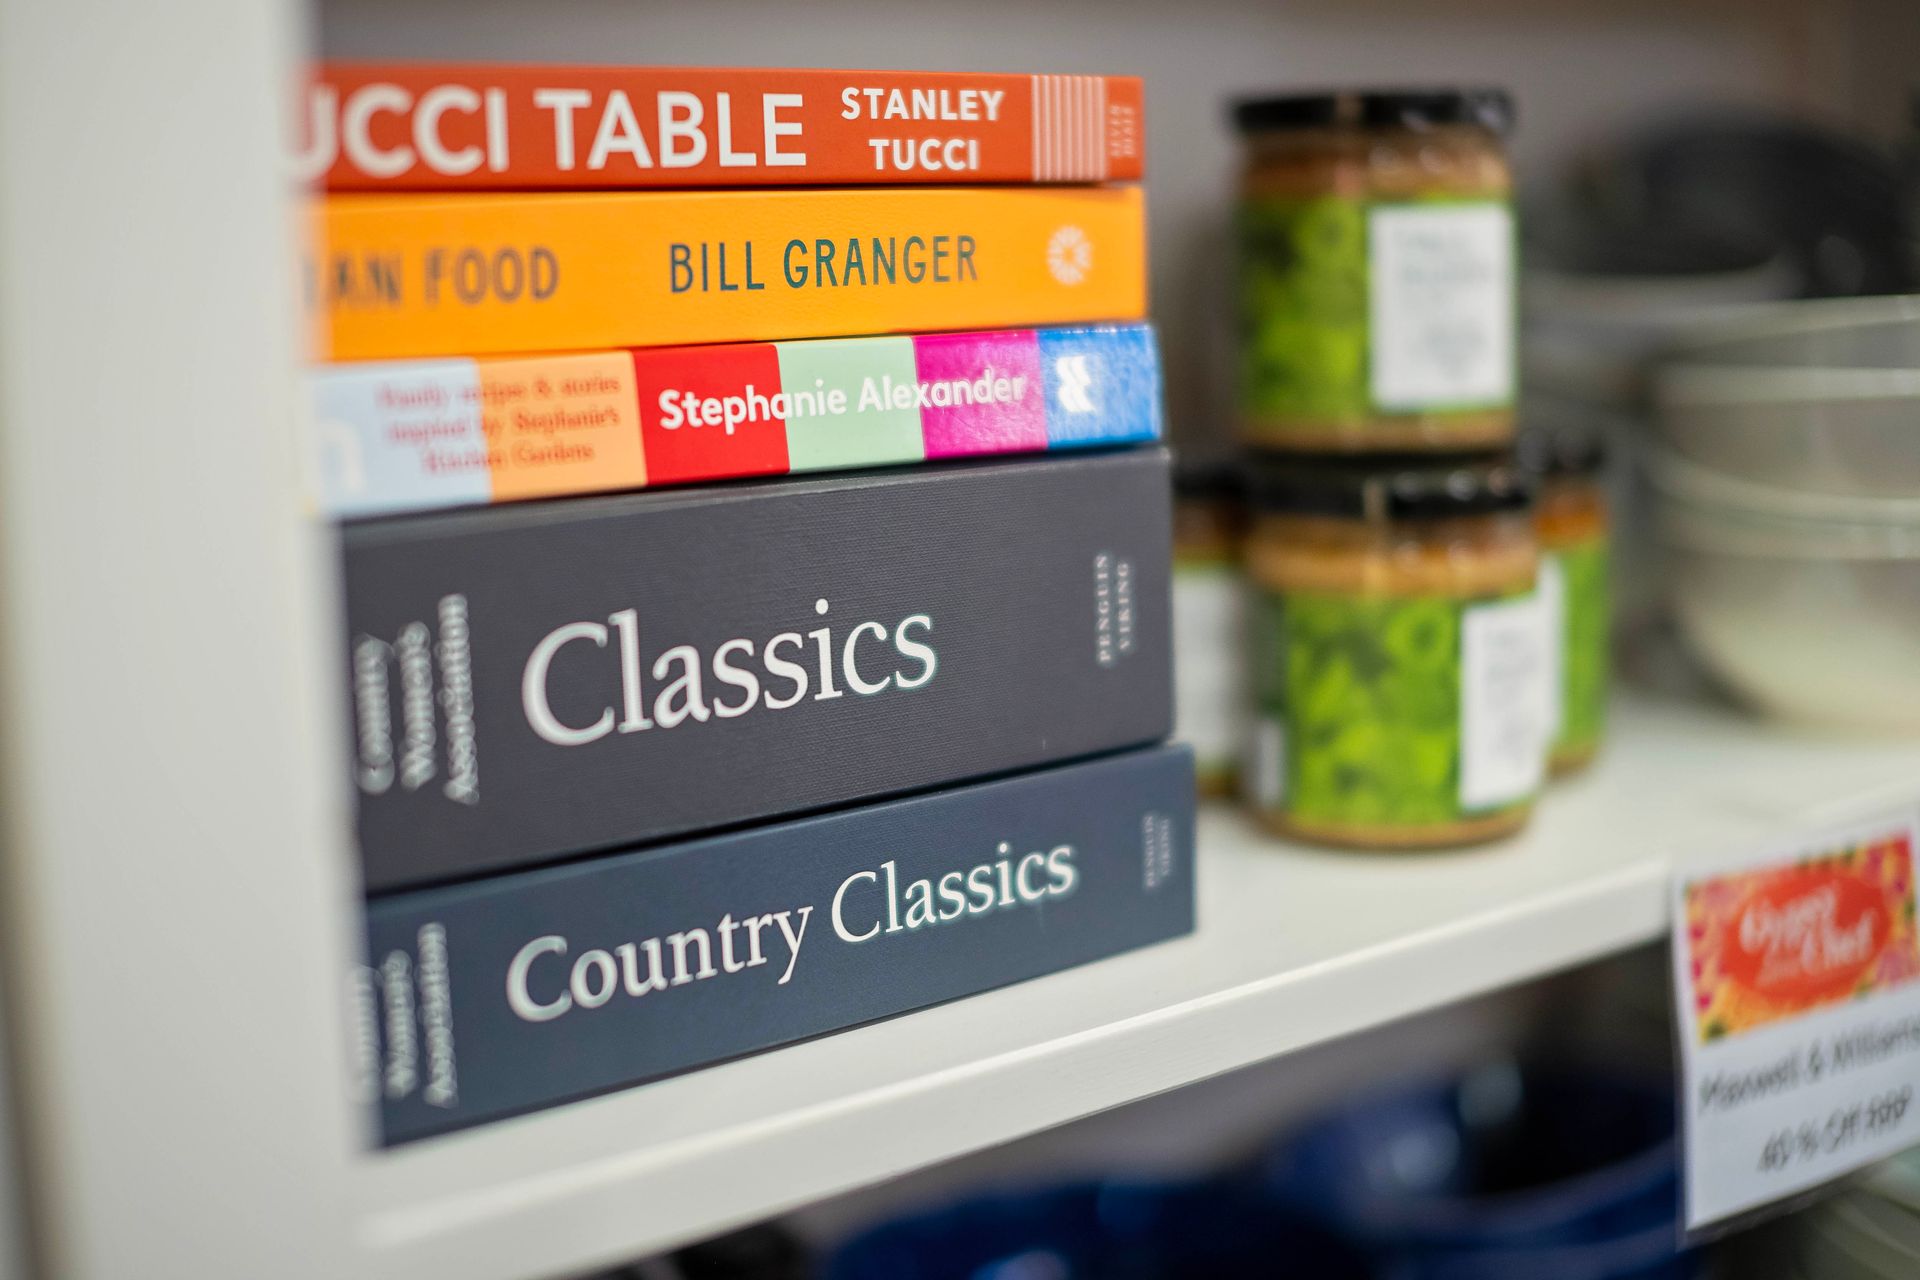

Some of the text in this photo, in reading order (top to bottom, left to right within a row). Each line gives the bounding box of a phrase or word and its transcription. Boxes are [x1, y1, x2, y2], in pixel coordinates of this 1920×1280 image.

[533, 86, 808, 171] TABLE
[840, 86, 1004, 122] STANLEY
[868, 138, 979, 171] TUCCI
[424, 245, 562, 308] FOOD
[669, 234, 979, 294] BILL GRANGER
[560, 373, 621, 397] stories
[658, 367, 1026, 436] Stephanie Alexander
[1095, 554, 1111, 664] PENGUIN
[1116, 562, 1131, 652] VIKING
[520, 598, 937, 746] Classics
[506, 842, 1078, 1023] Country Classics
